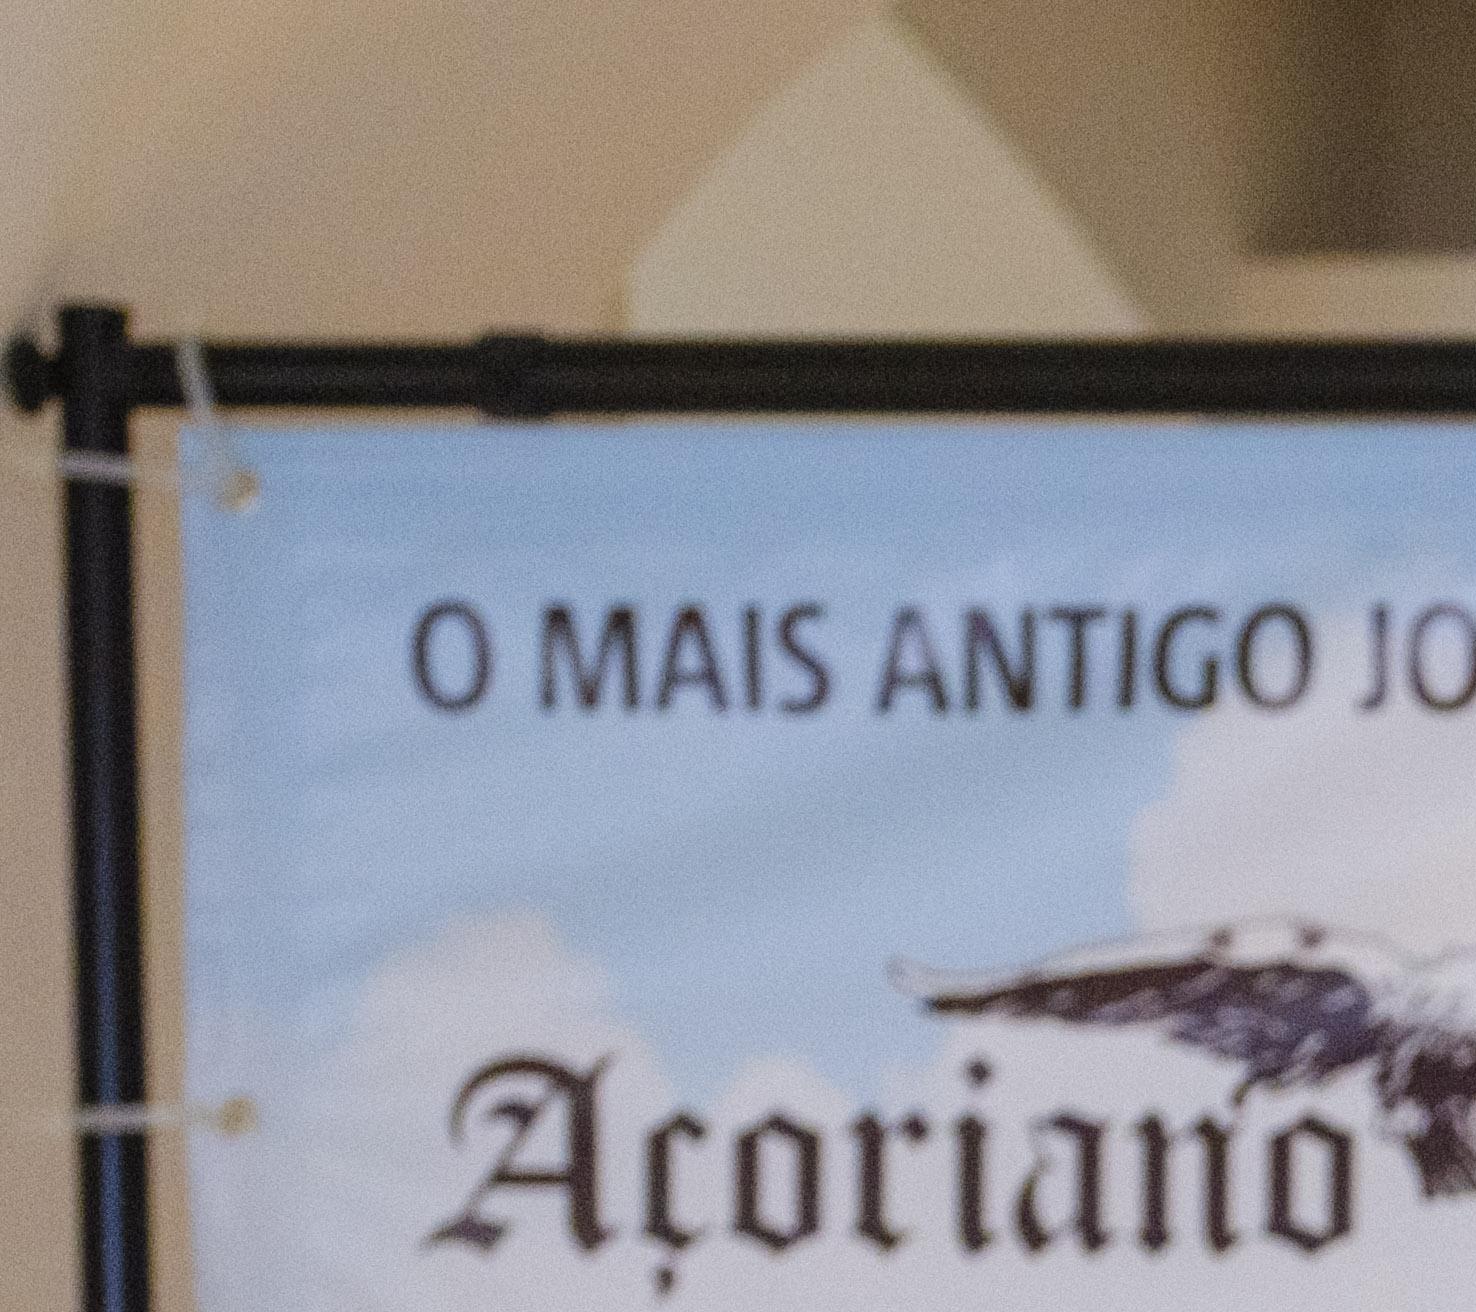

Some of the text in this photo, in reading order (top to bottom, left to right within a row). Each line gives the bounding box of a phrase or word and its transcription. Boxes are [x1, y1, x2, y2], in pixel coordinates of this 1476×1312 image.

[408, 596, 494, 716] O
[537, 598, 832, 716] MAIS
[874, 598, 1316, 717] ANTIGO
[420, 1052, 1364, 1300] Açoriano
